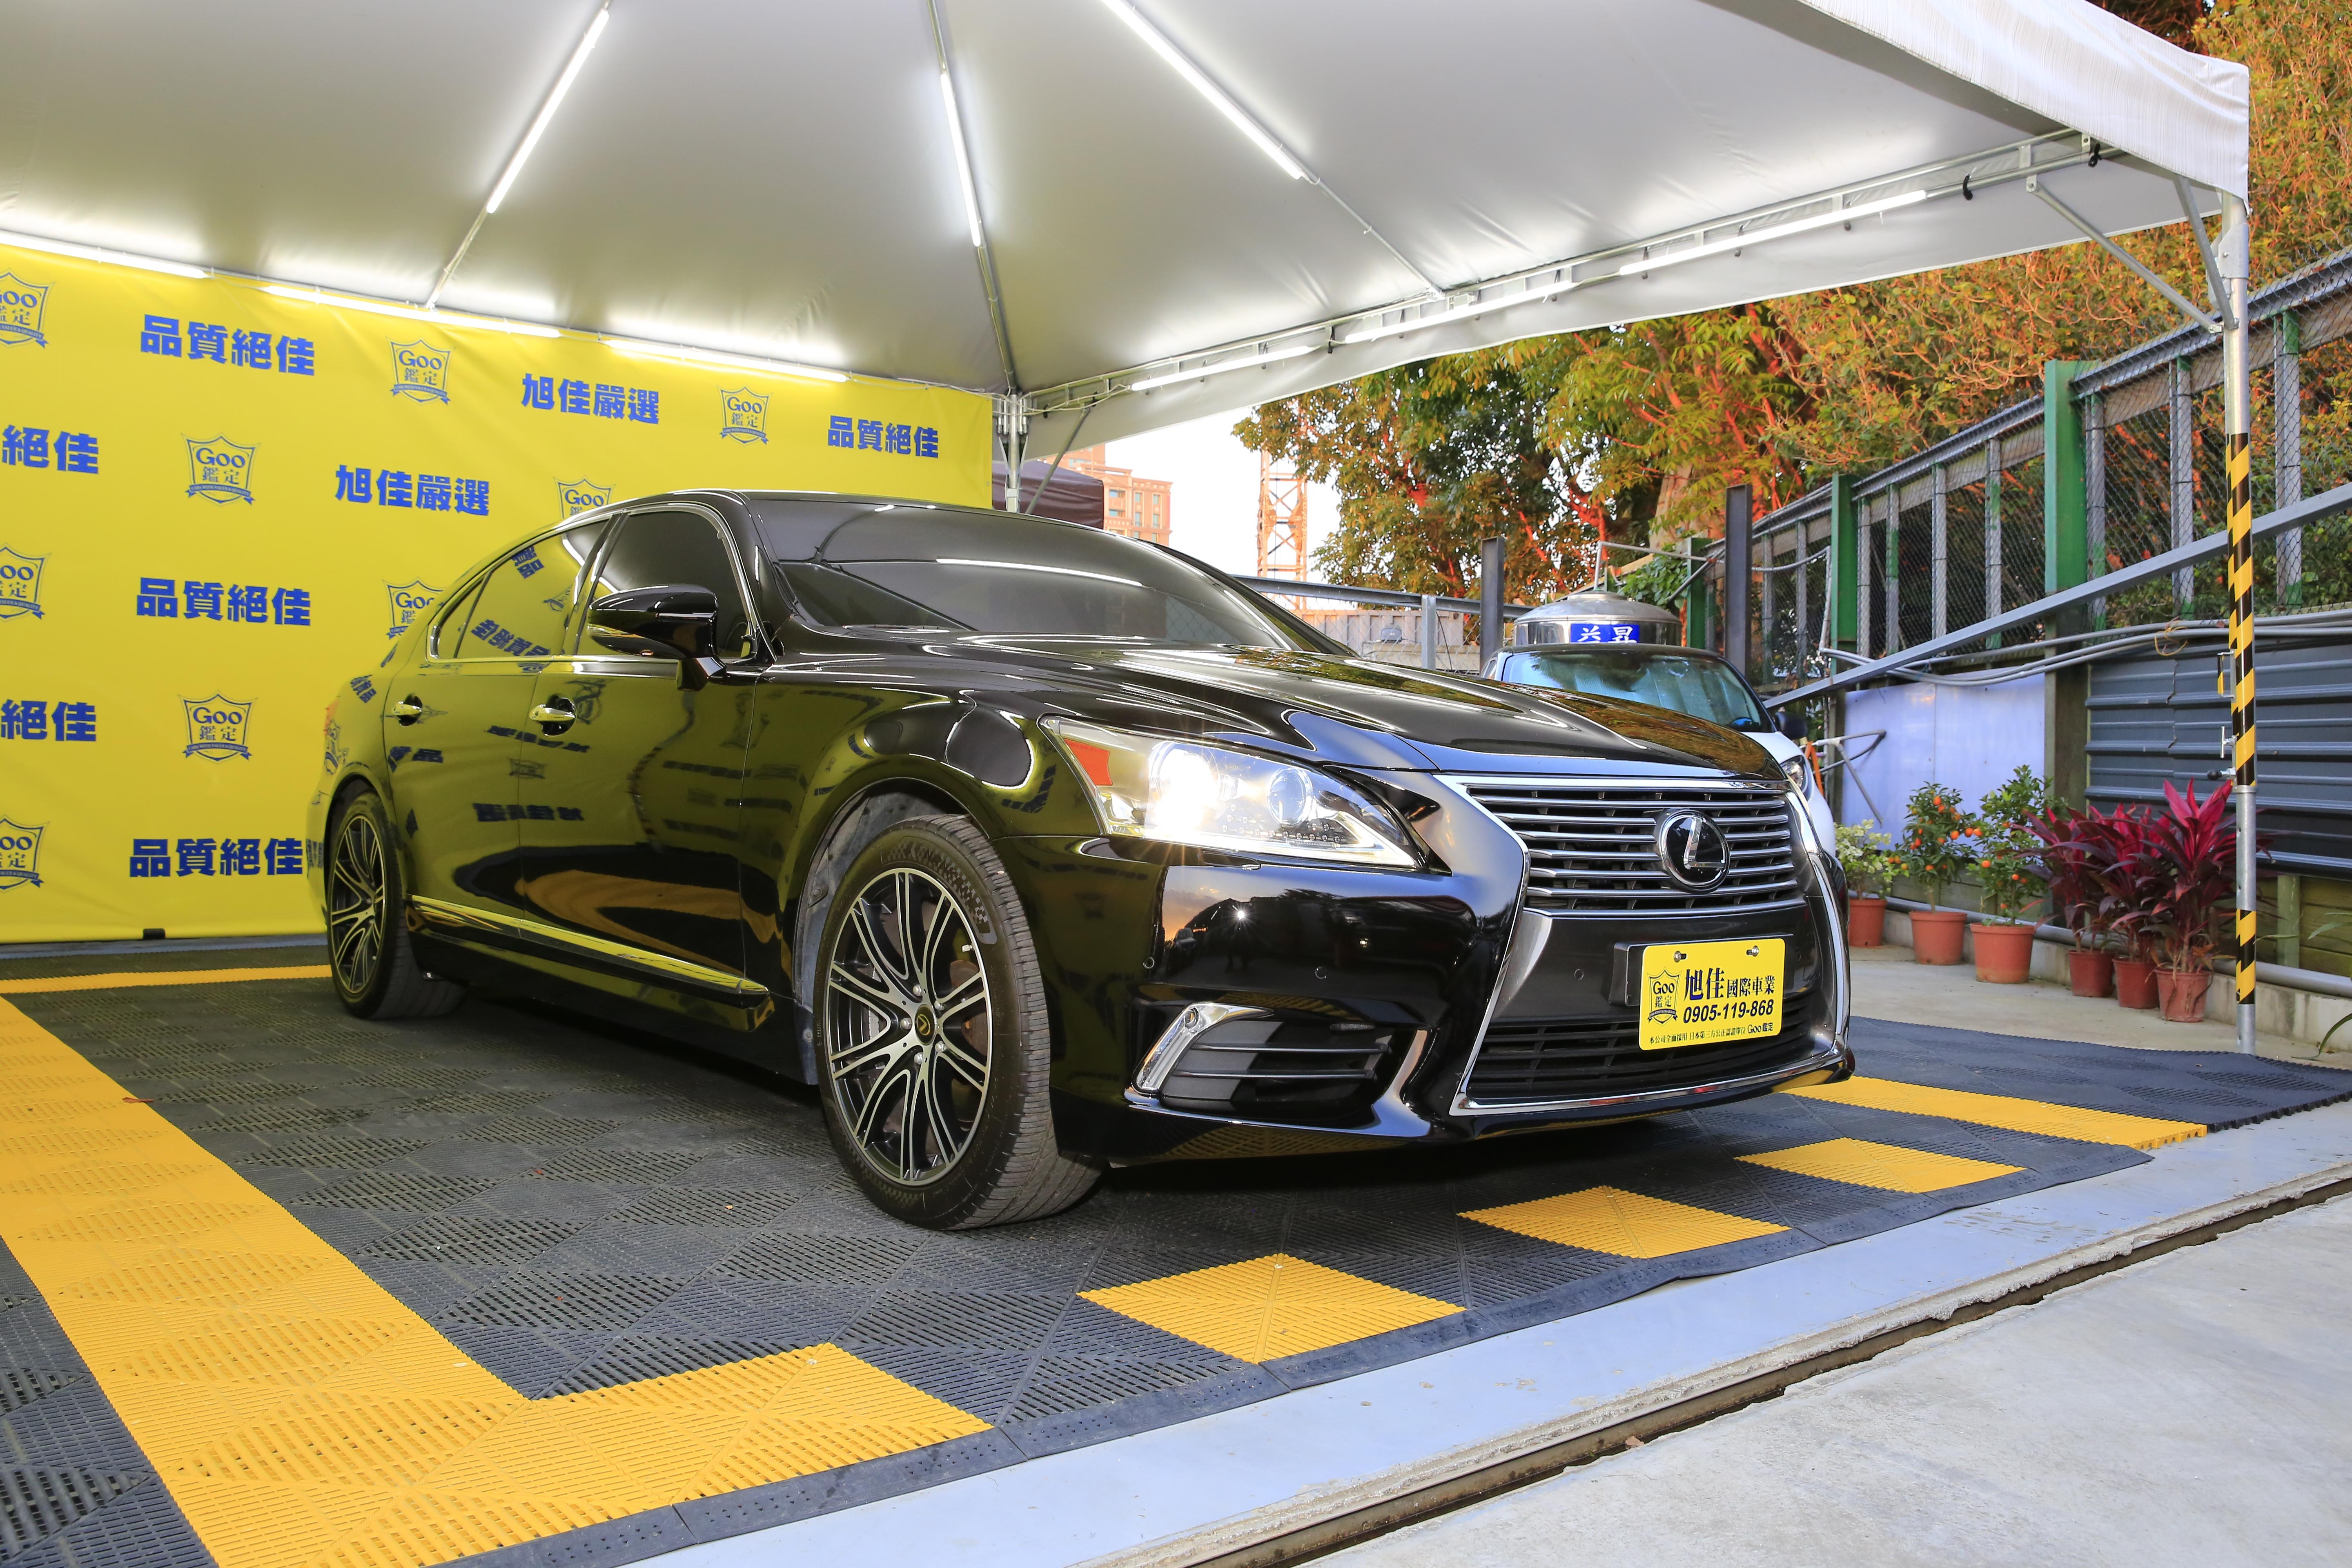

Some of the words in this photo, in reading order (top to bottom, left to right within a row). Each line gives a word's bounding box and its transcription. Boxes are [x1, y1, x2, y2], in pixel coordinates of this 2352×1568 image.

[0, 289, 37, 307] oo
[141, 314, 314, 376] 品質絕佳
[399, 350, 442, 370] Goo
[405, 368, 437, 385] 鑑定
[521, 373, 659, 424] 旭佳嚴選
[727, 396, 762, 414] Goo
[732, 412, 758, 428] 鑑定
[828, 415, 938, 458] 品質絕佳
[196, 448, 245, 468] Goo
[203, 466, 240, 485] 鑑定
[335, 465, 490, 517] 旭佳嚴選
[565, 489, 604, 507] Goo
[137, 577, 311, 626] 品質絕佳
[193, 707, 242, 724] Goo
[199, 725, 236, 741] 鑑定
[129, 838, 303, 878] 品質絕佳
[1653, 981, 1675, 995] Goo
[1655, 995, 1672, 1008] 鑑定
[1683, 999, 1774, 1023] 0905-119-868
[1649, 1033, 1687, 1045] 本公司全面採用
[1747, 1024, 1762, 1033] Goo
[1762, 1022, 1773, 1031] 鑑定
